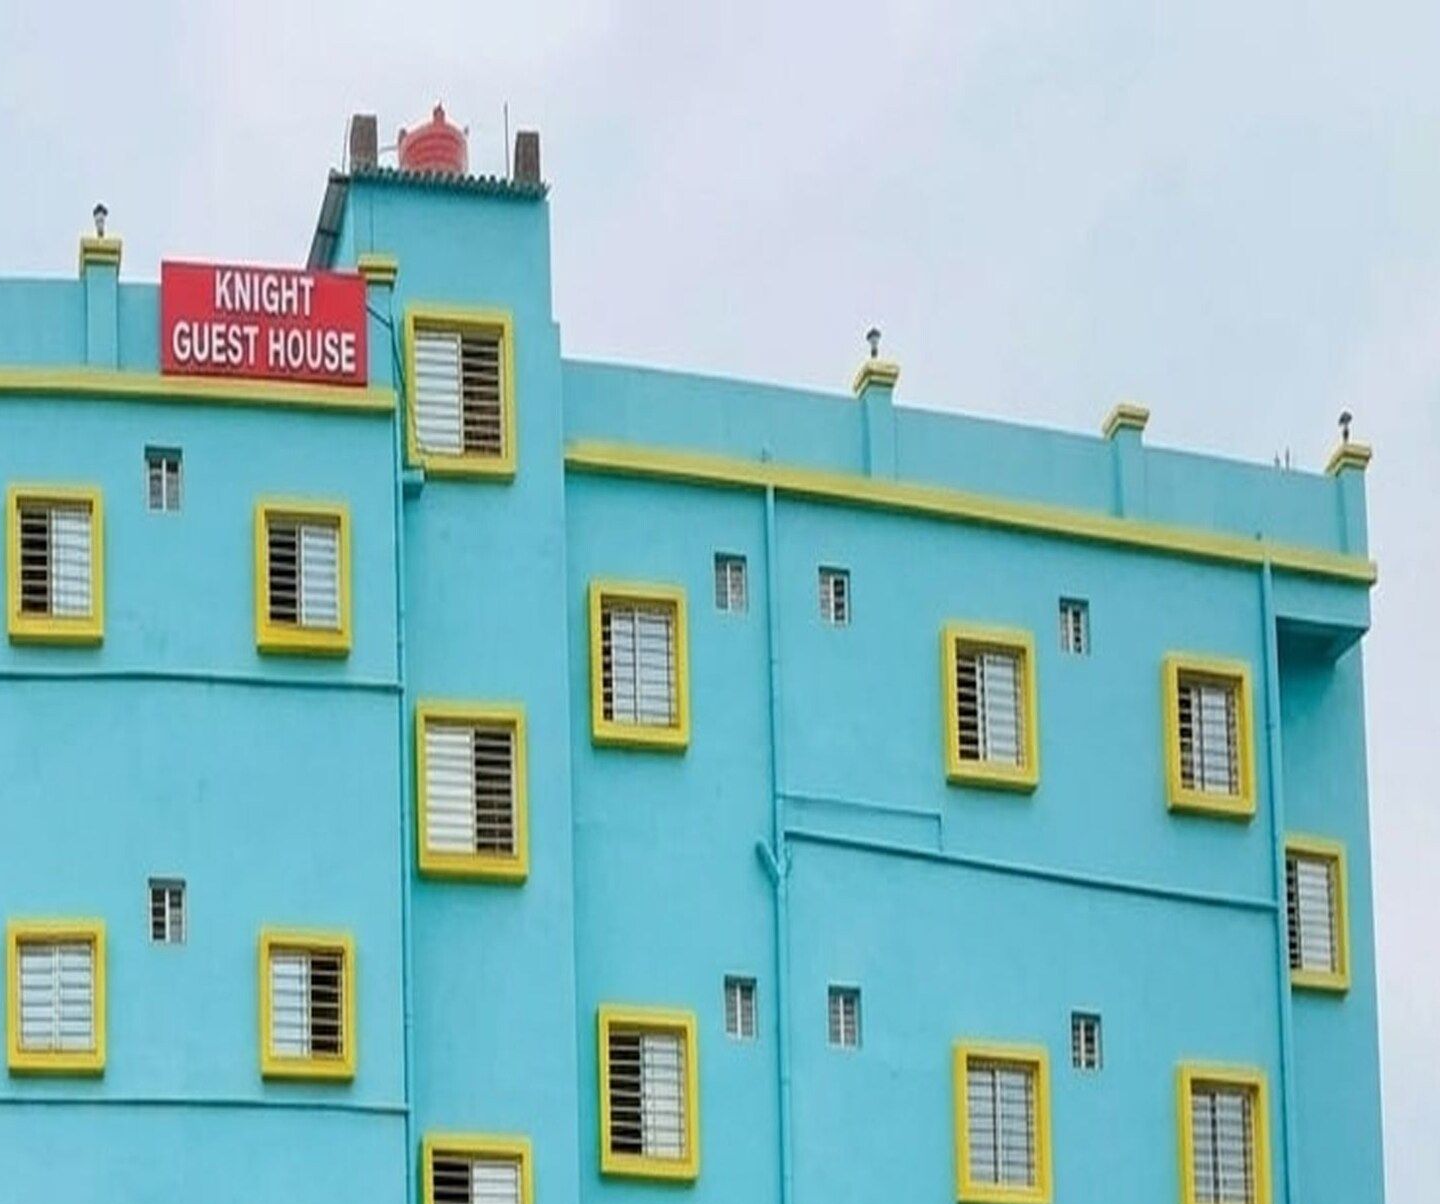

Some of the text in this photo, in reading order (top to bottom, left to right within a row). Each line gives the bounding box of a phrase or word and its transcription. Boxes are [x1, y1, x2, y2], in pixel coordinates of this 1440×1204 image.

[215, 270, 314, 316] KNIGHT
[173, 321, 356, 372] GUEST HOUSE
